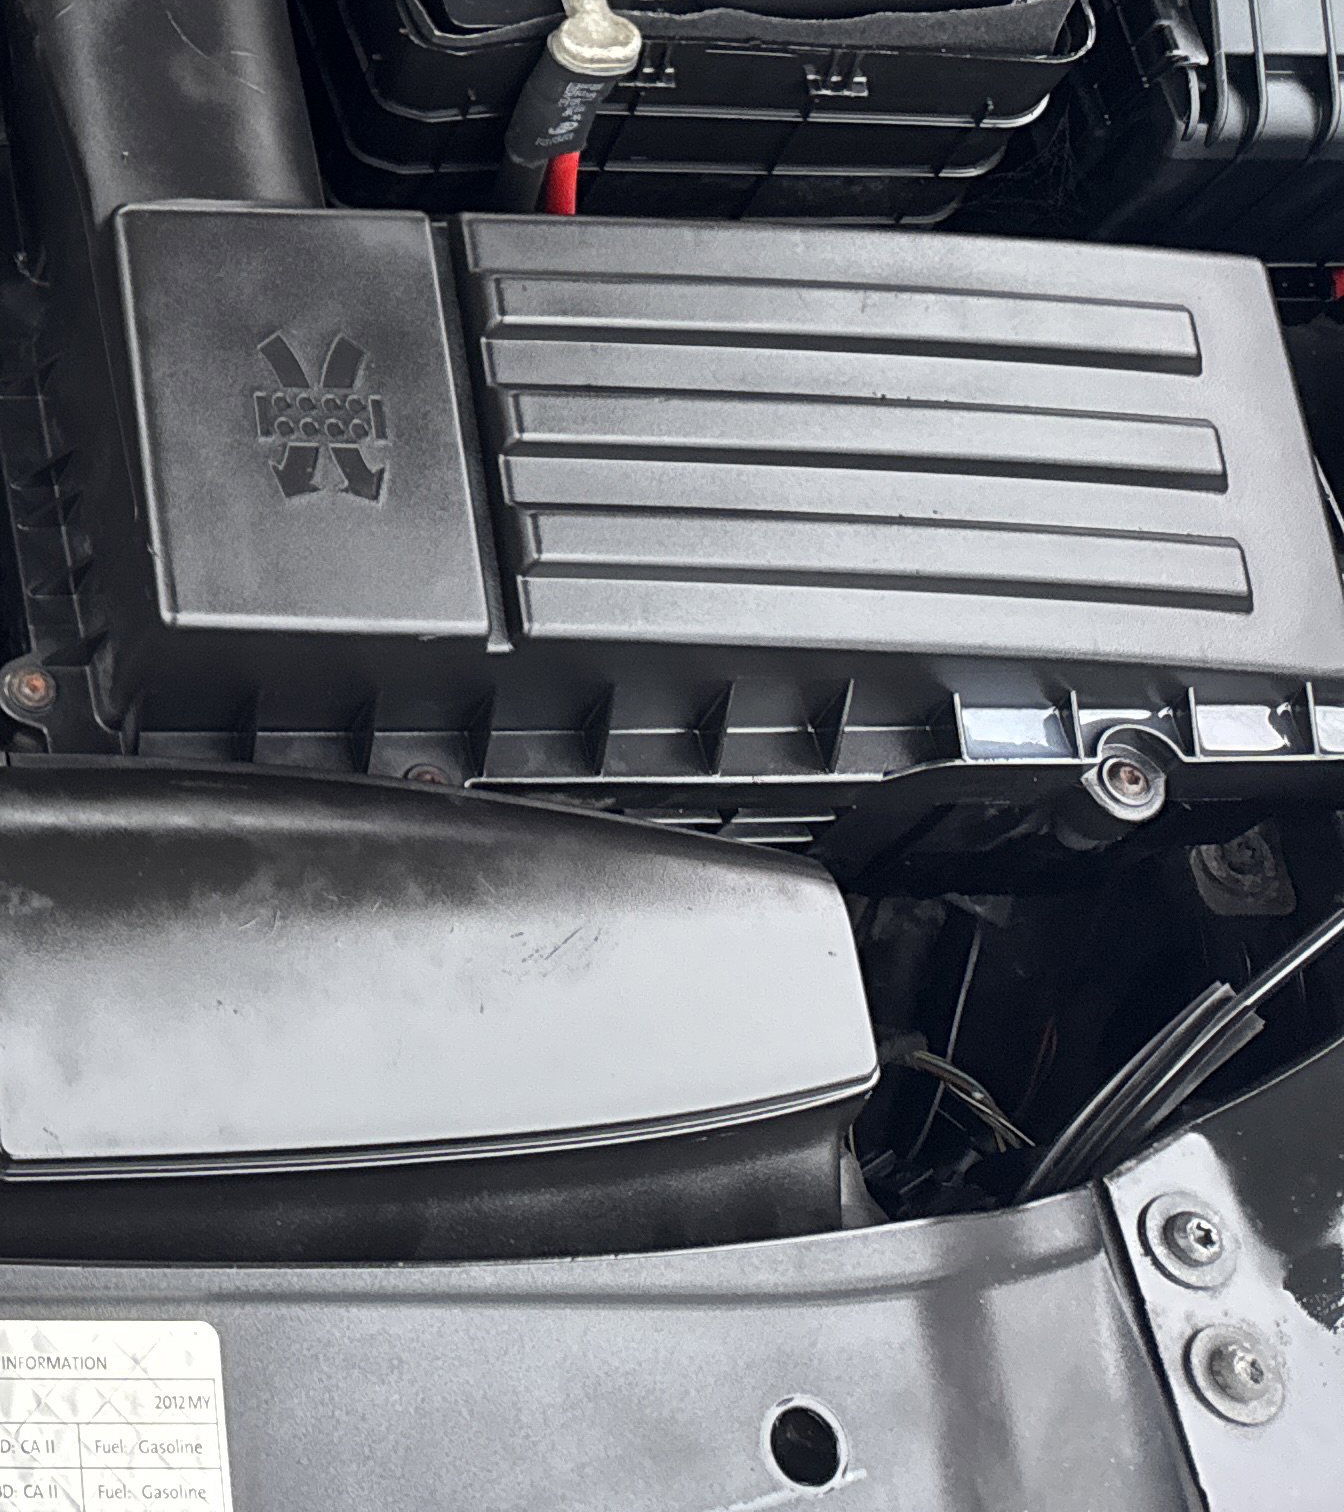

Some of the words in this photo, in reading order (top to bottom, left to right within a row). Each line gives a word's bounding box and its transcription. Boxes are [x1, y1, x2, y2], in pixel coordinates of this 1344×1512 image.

[1, 1356, 108, 1371] INFORMATION
[154, 1395, 185, 1410] 2012
[188, 1396, 211, 1410] MY
[20, 1439, 41, 1454] CA
[45, 1439, 55, 1454] II
[138, 1439, 203, 1455] Gasoline
[23, 1484, 44, 1499] CA
[48, 1484, 58, 1499] II
[141, 1484, 207, 1501] Gasoline
